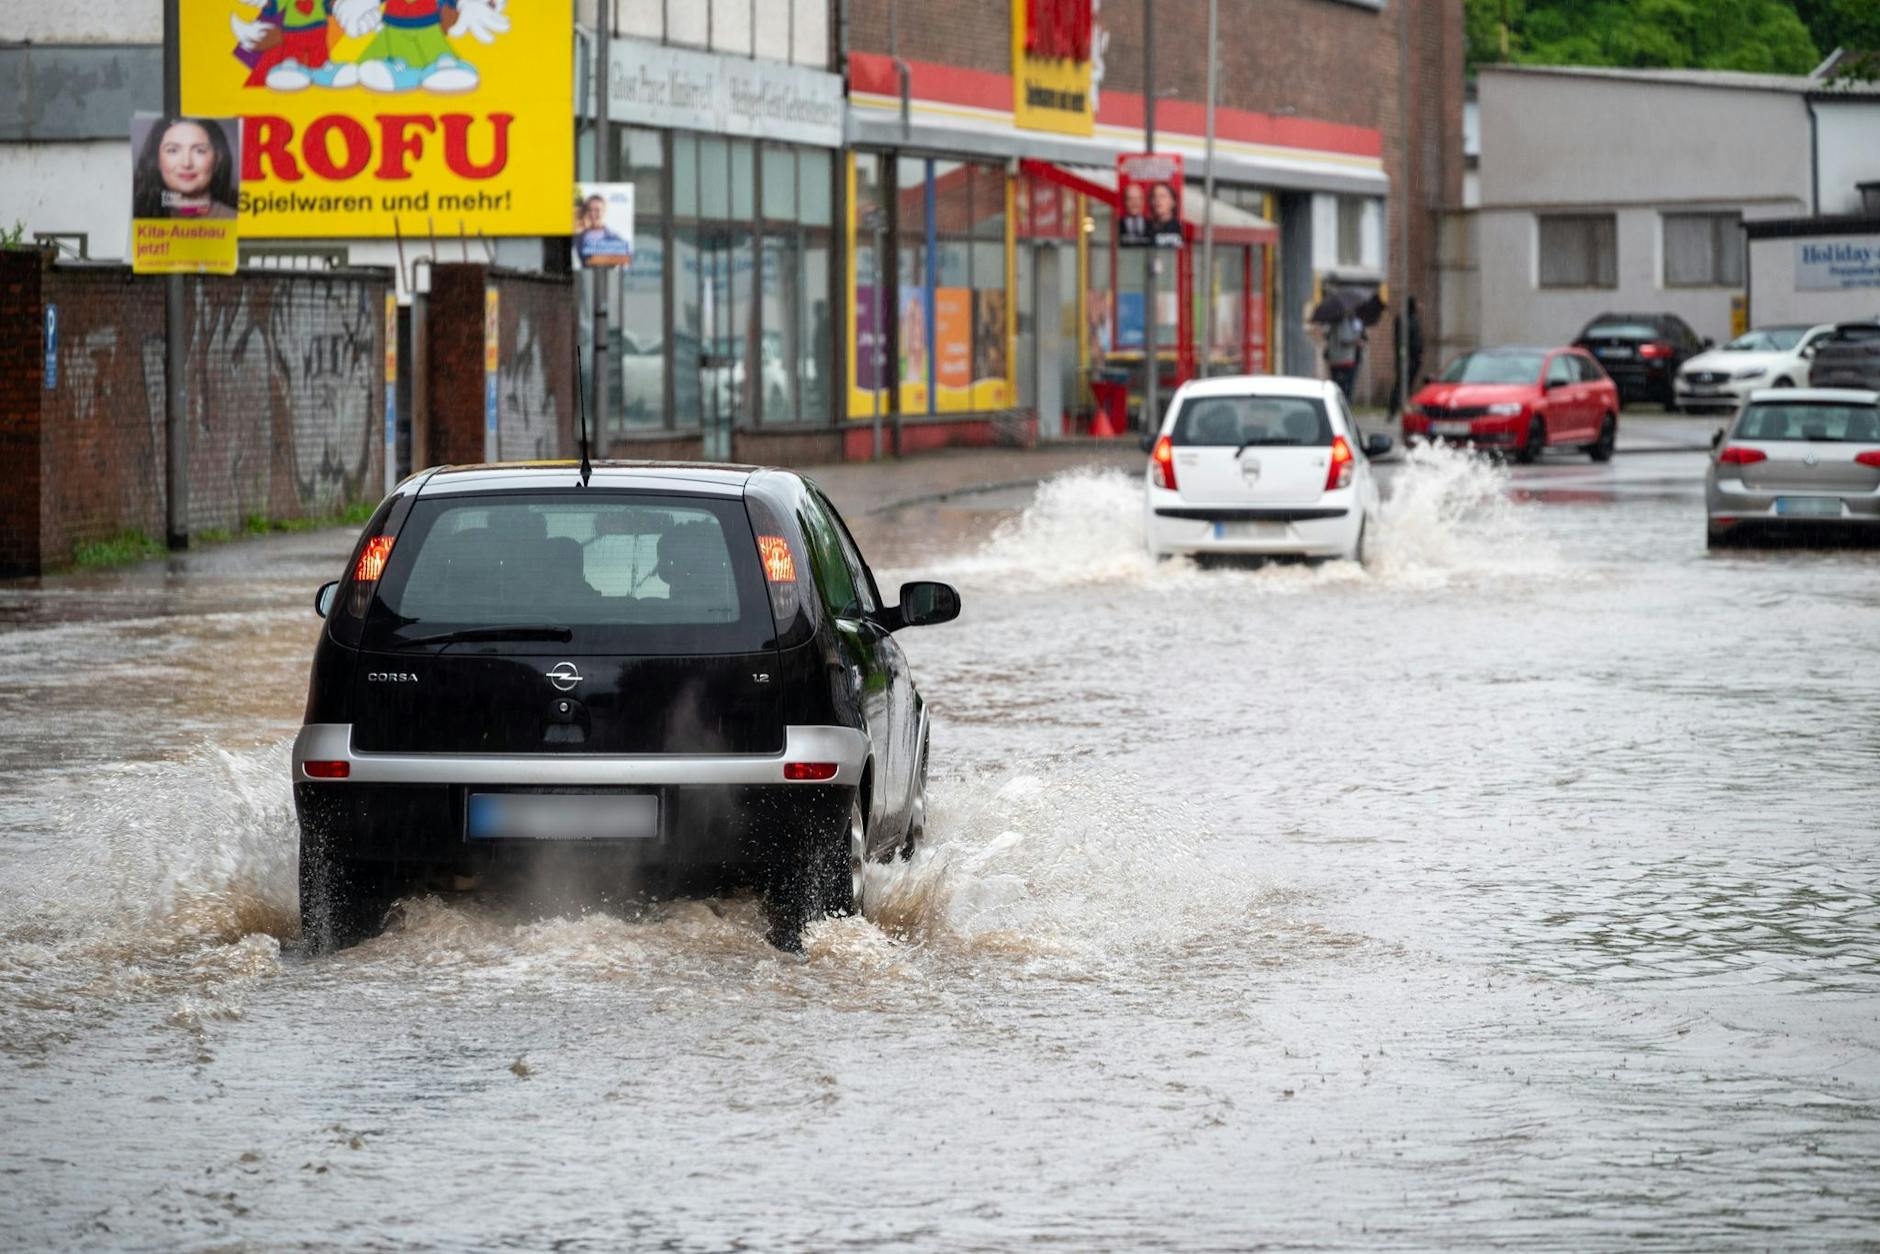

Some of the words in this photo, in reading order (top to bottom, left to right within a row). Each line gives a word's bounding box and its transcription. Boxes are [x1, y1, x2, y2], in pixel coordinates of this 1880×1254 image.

[240, 114, 515, 182] ROFU
[237, 192, 373, 215] Spielwaren
[382, 191, 430, 211] und
[438, 190, 512, 210] mehr!
[137, 224, 226, 239] Kita-Ausbau
[137, 242, 170, 258] jetzt!
[367, 672, 418, 682] CORSA
[752, 673, 770, 683] 1.2
